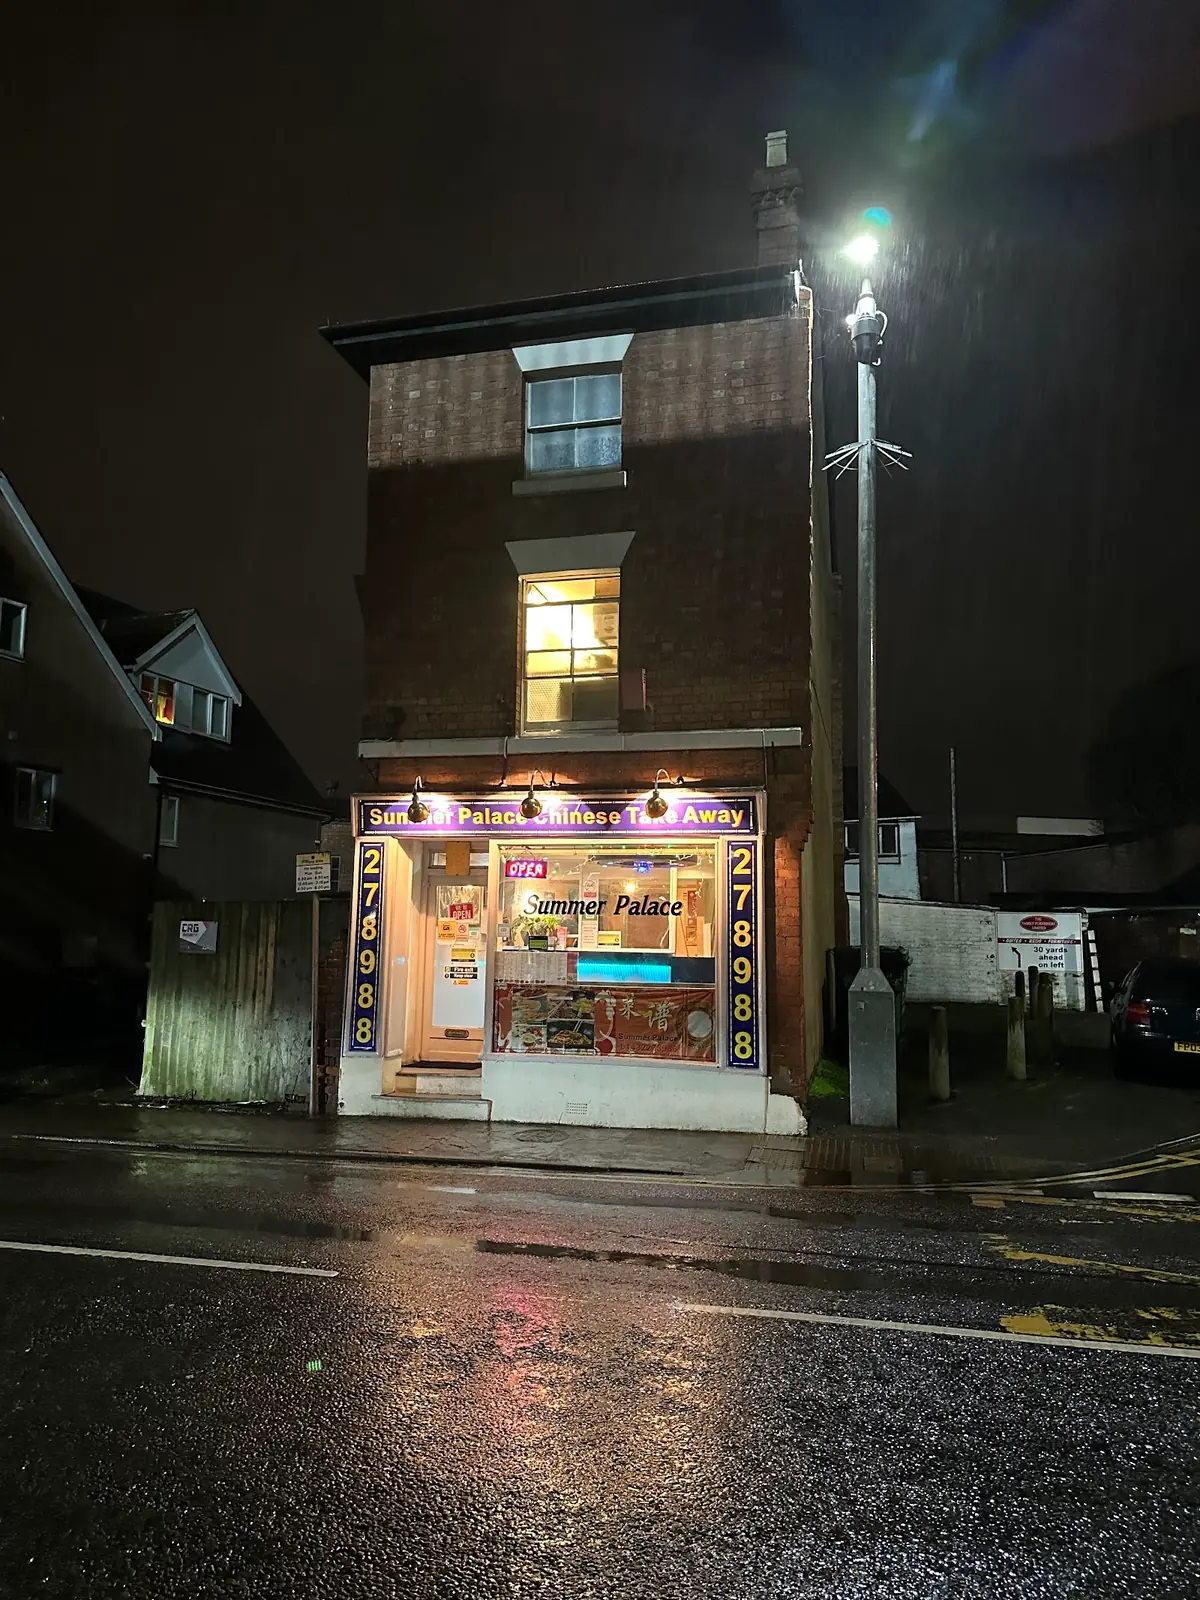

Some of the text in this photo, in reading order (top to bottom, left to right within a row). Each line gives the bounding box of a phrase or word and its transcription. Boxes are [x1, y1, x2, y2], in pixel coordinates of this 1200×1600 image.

[370, 808, 454, 826] Sumer
[458, 807, 530, 825] Palace
[682, 805, 744, 828] Away
[509, 861, 543, 876] OPEN
[524, 894, 683, 916] Summer Palace
[182, 924, 199, 932] CRG
[652, 1034, 679, 1042] Palace
